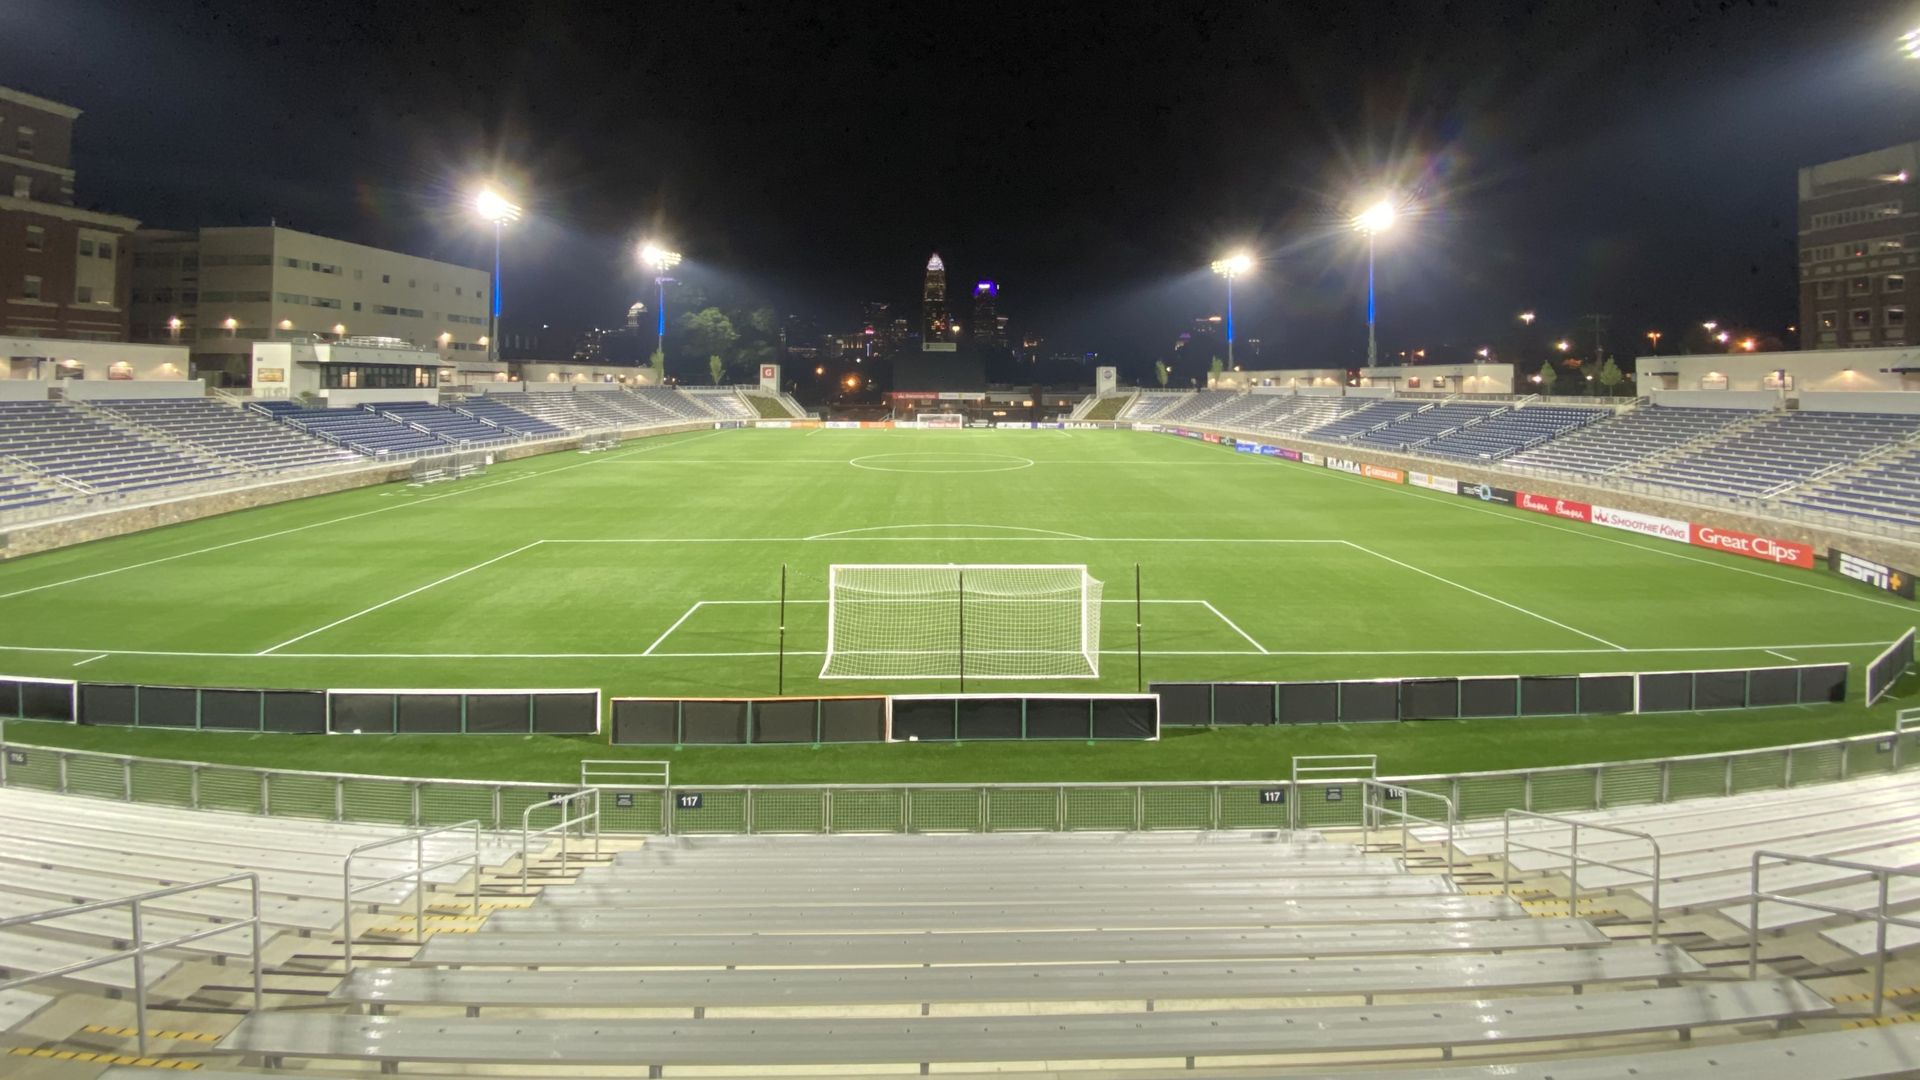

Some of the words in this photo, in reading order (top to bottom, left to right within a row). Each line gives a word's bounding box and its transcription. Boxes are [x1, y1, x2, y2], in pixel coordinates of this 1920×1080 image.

[1698, 527, 1749, 551] Great
[1751, 538, 1797, 562] Clips
[681, 796, 698, 807] 117
[1264, 791, 1281, 802] 117
